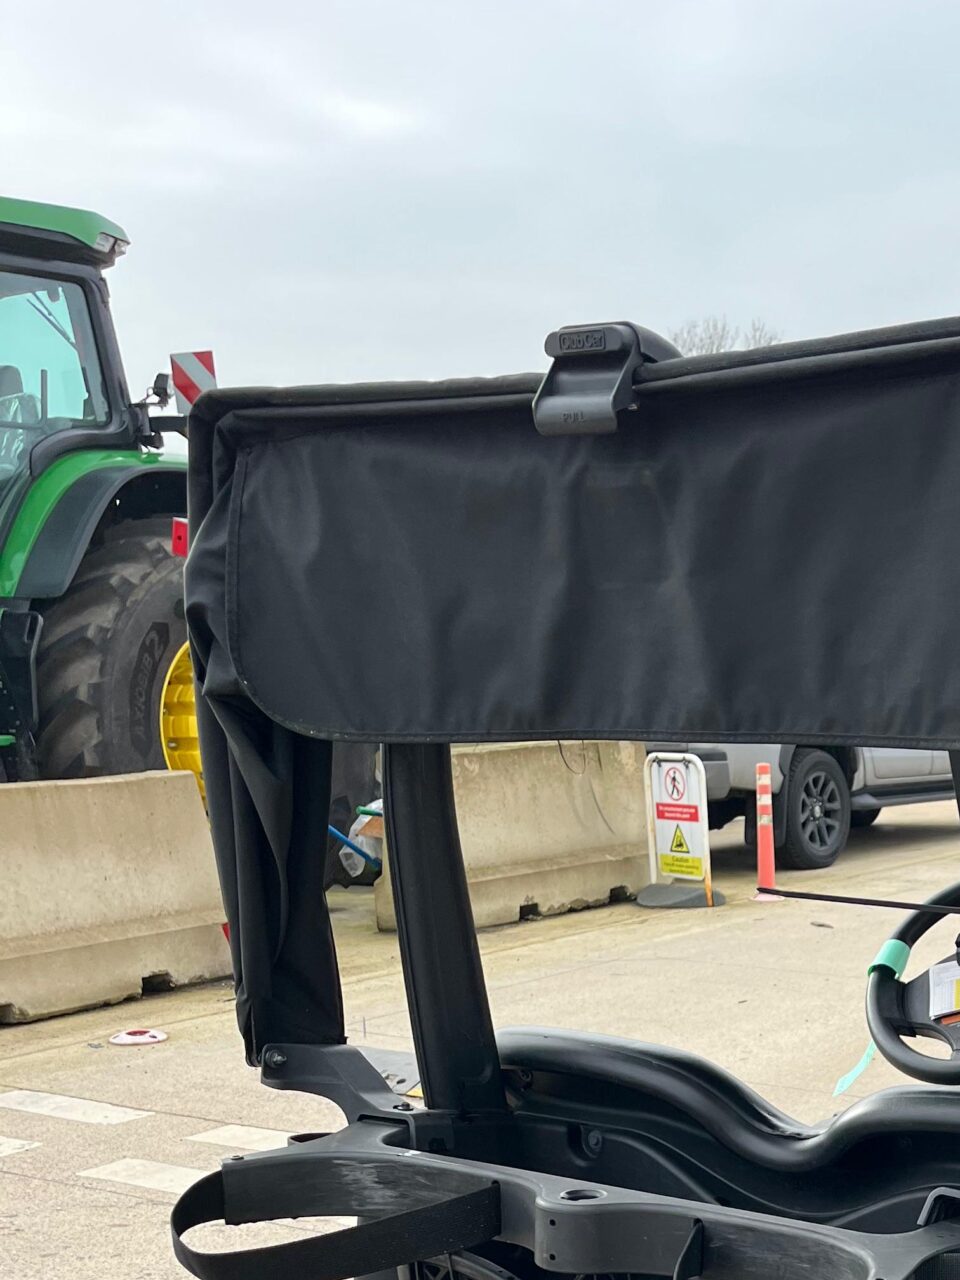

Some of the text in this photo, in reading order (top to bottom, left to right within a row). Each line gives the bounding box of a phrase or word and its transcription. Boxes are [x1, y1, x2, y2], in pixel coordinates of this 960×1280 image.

[562, 333, 603, 349] Club Car
[562, 412, 585, 423] PULL
